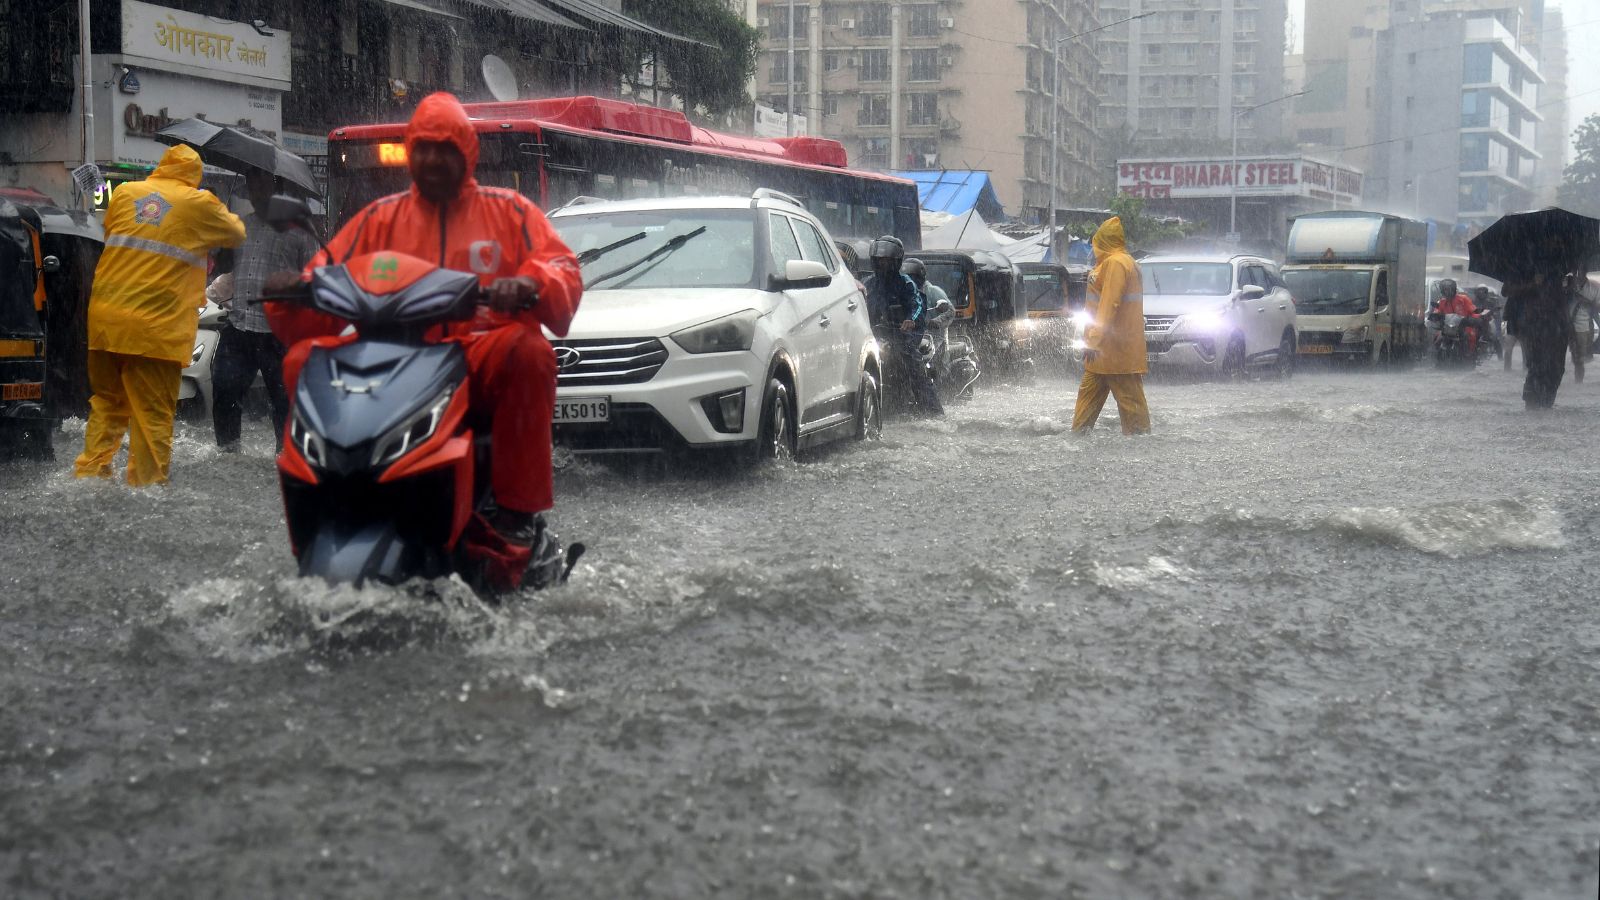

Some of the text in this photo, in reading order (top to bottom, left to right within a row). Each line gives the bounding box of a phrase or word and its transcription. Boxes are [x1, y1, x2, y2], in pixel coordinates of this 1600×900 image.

[154, 14, 234, 62] ओमकार
[1174, 163, 1241, 187] BHARAT
[1245, 162, 1298, 185] STEEL
[553, 402, 608, 419] EK5019
